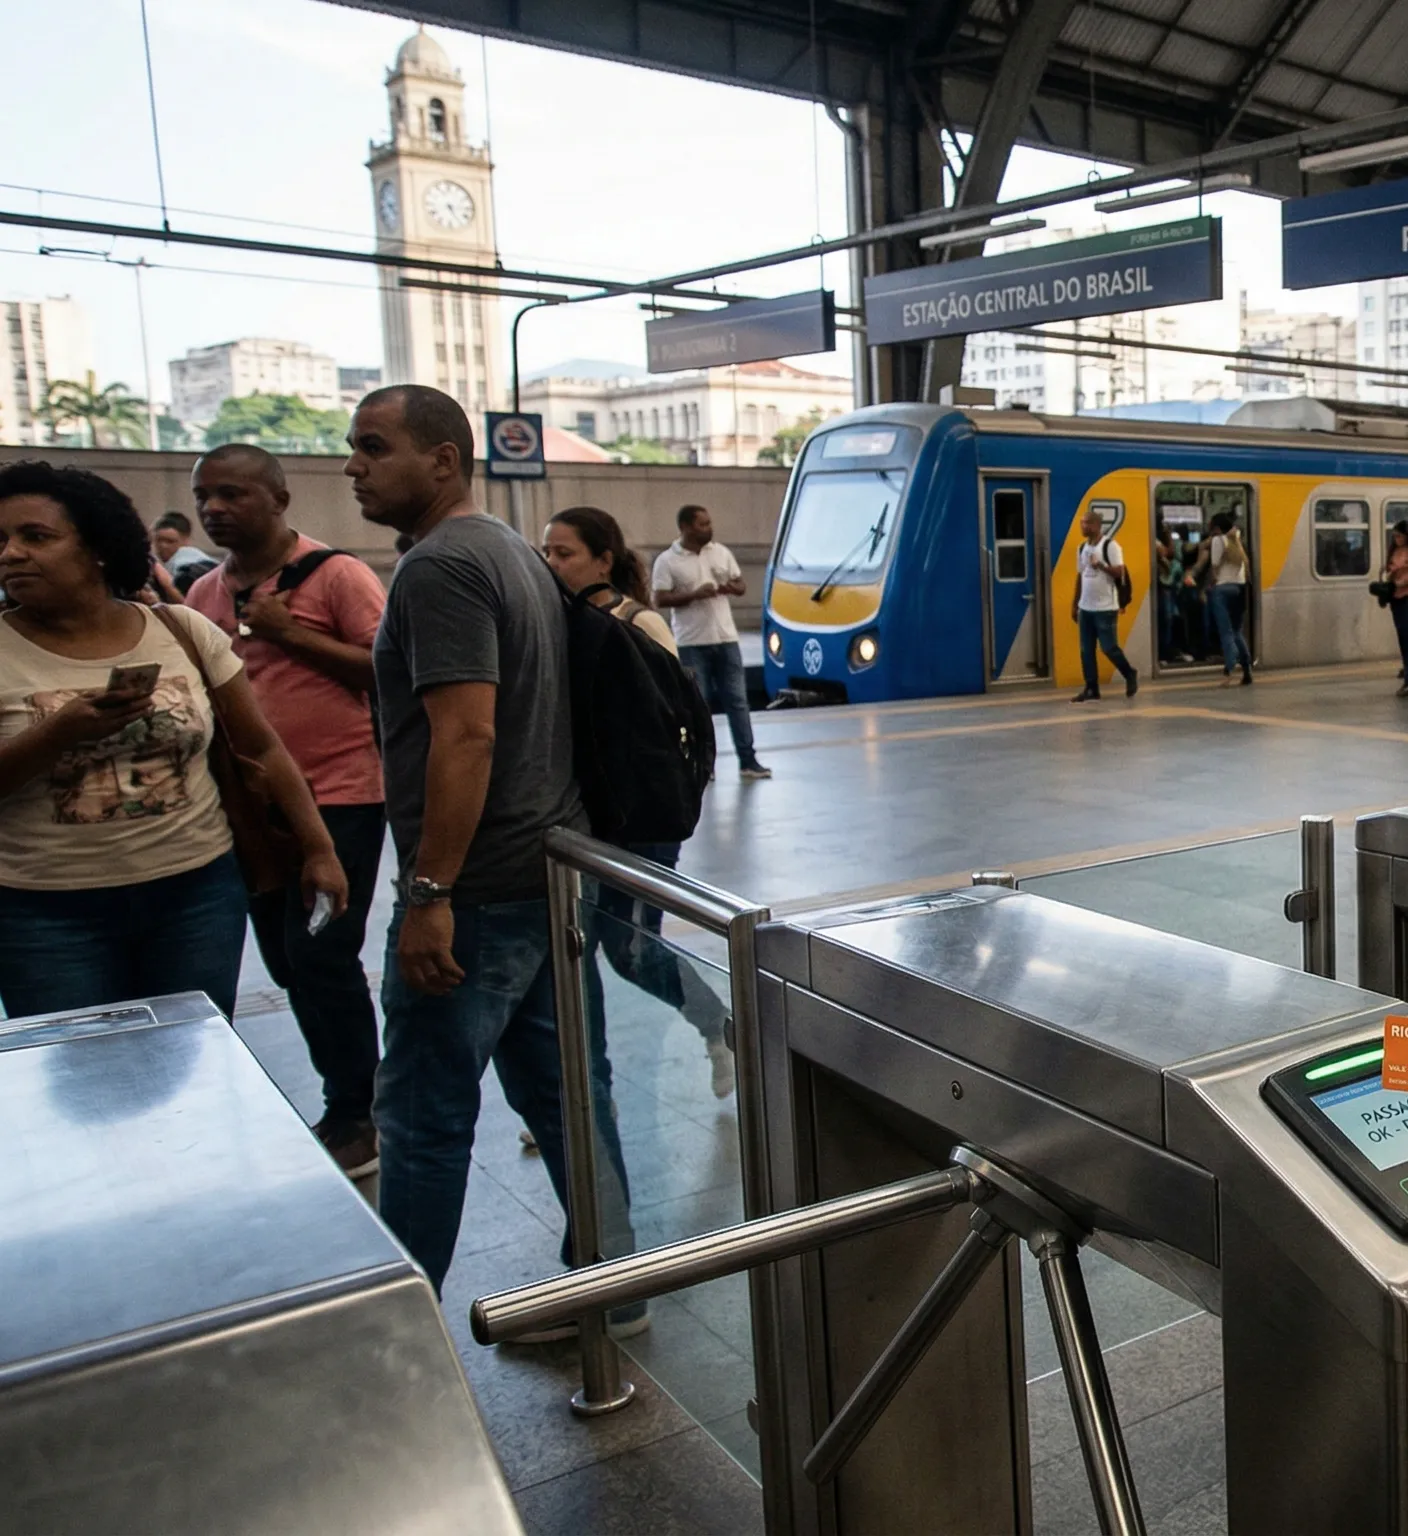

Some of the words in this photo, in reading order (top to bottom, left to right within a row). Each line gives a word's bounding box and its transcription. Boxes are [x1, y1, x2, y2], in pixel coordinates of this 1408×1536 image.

[903, 292, 971, 328] ESTAÇÃO
[974, 283, 1049, 316] CENTRAL
[1053, 277, 1081, 304] DO
[1086, 267, 1153, 299] BRASIL
[1368, 1126, 1394, 1143] OK
